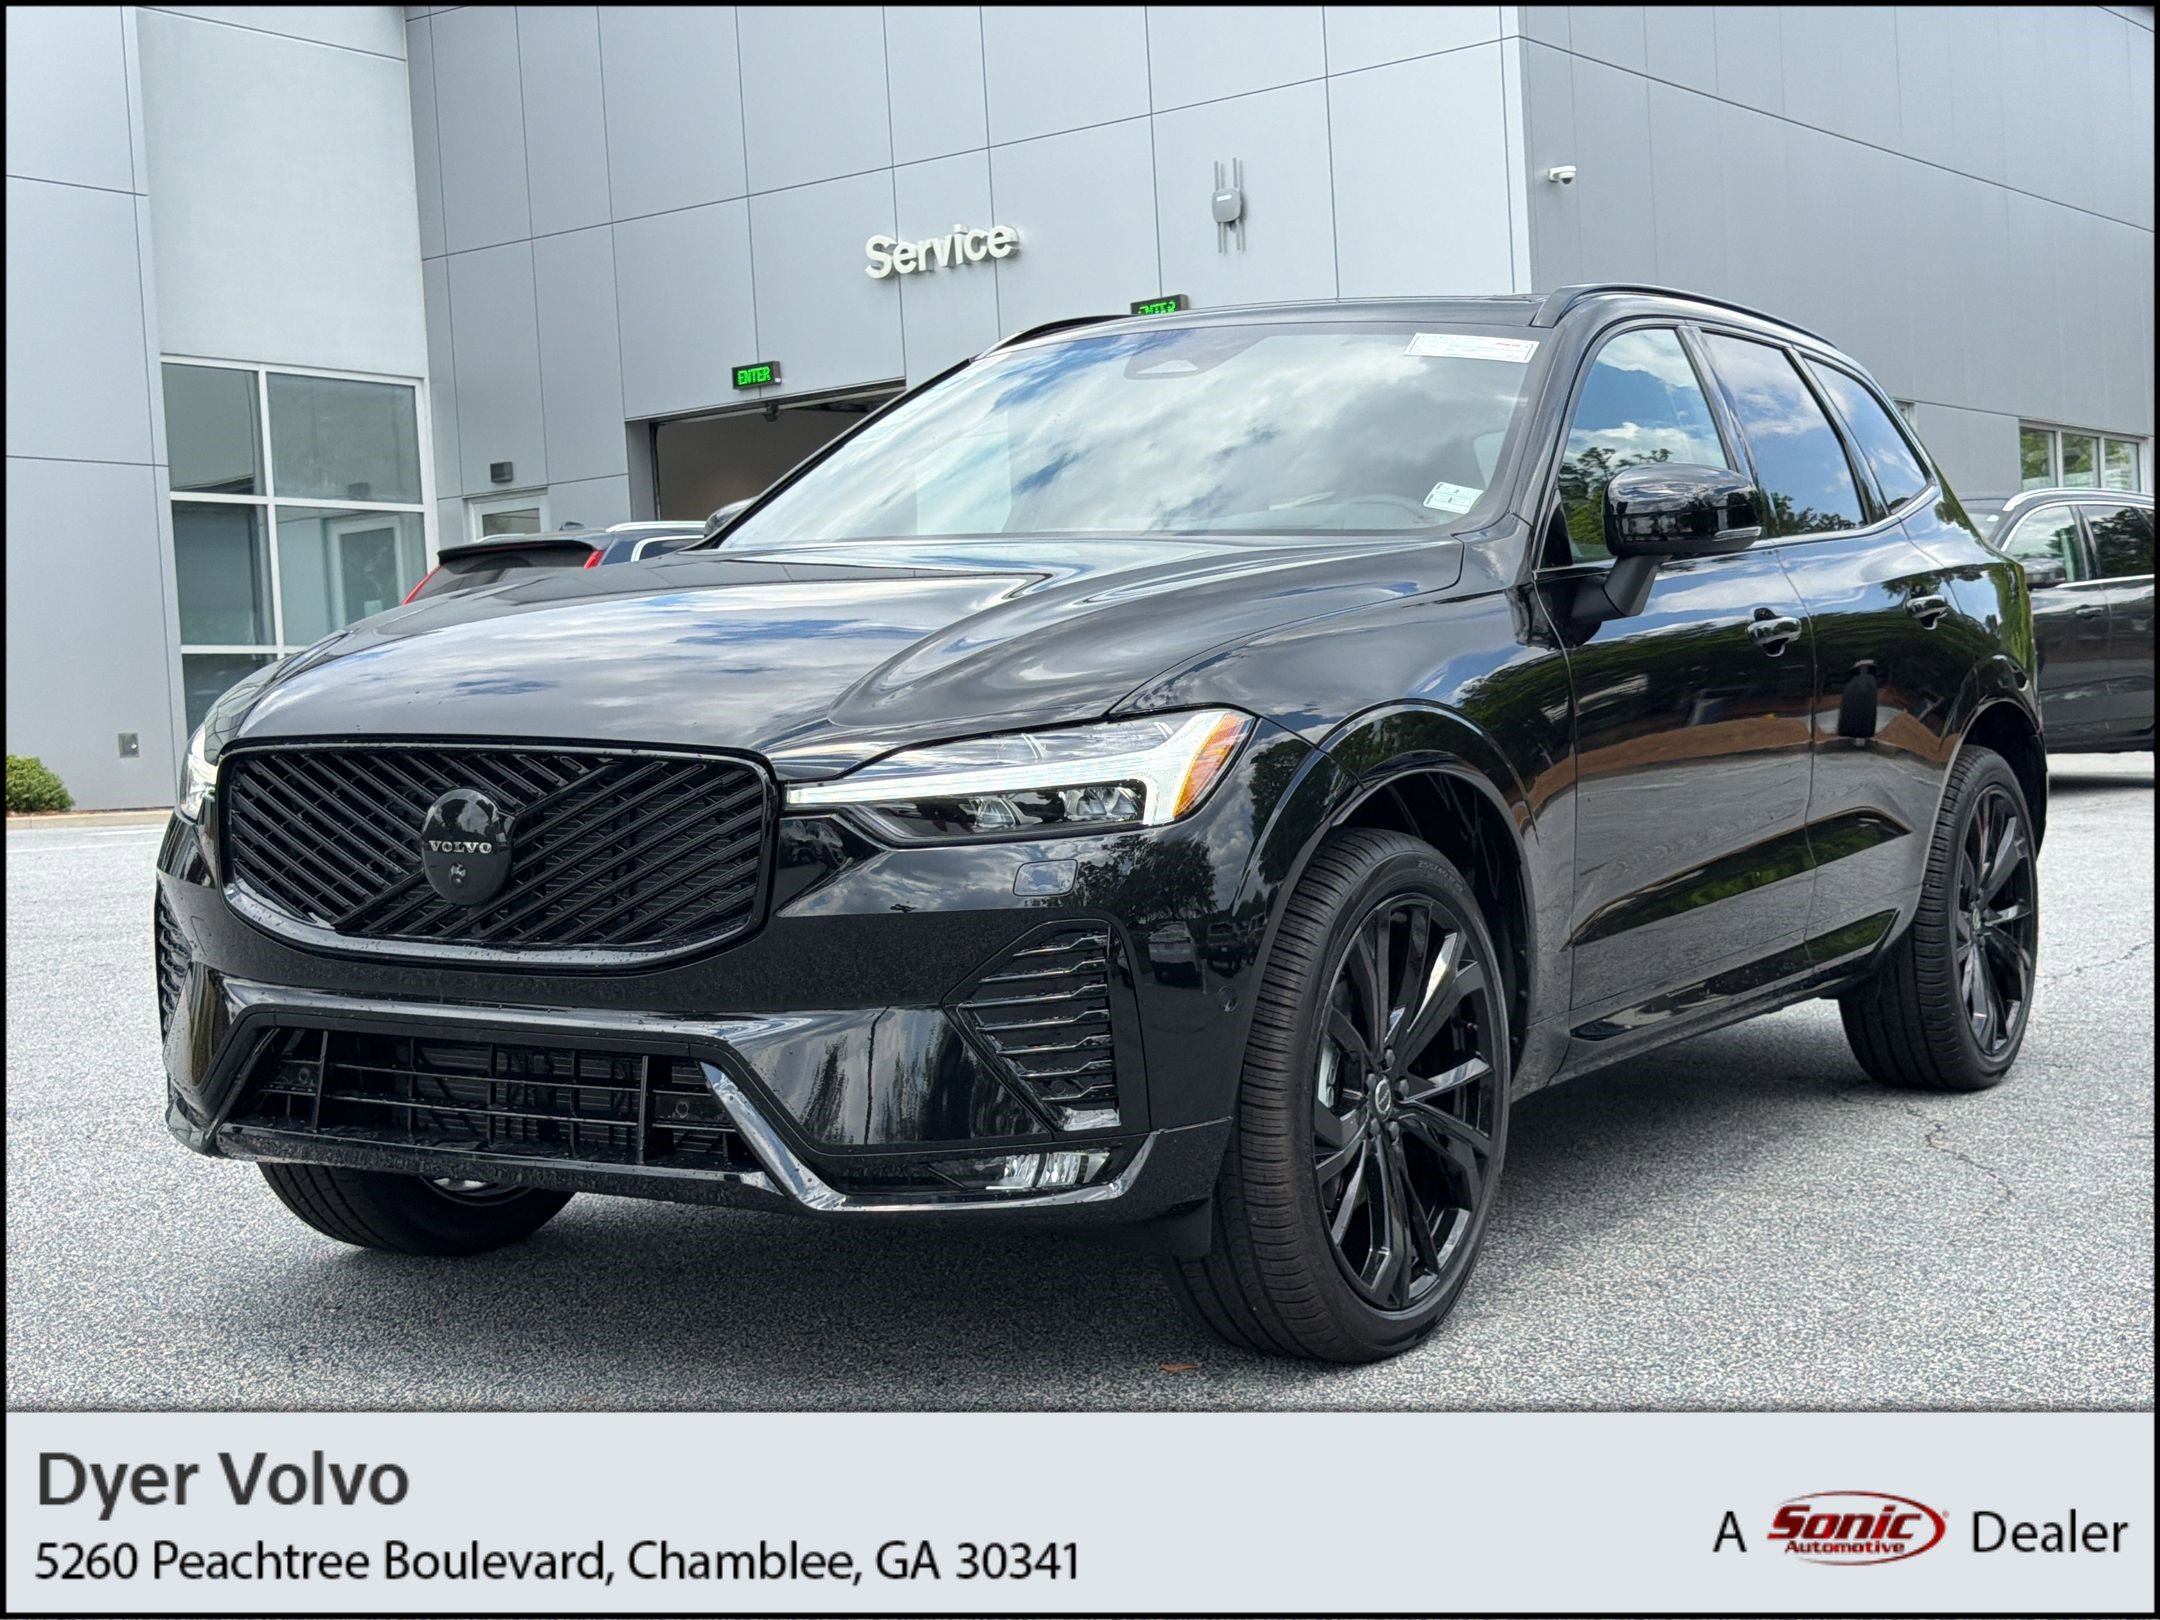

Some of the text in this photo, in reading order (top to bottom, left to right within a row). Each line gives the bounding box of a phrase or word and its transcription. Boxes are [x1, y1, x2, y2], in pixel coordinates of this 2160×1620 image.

[865, 224, 1020, 279] Service
[737, 366, 771, 385] ENTER
[429, 840, 493, 854] VOLVO
